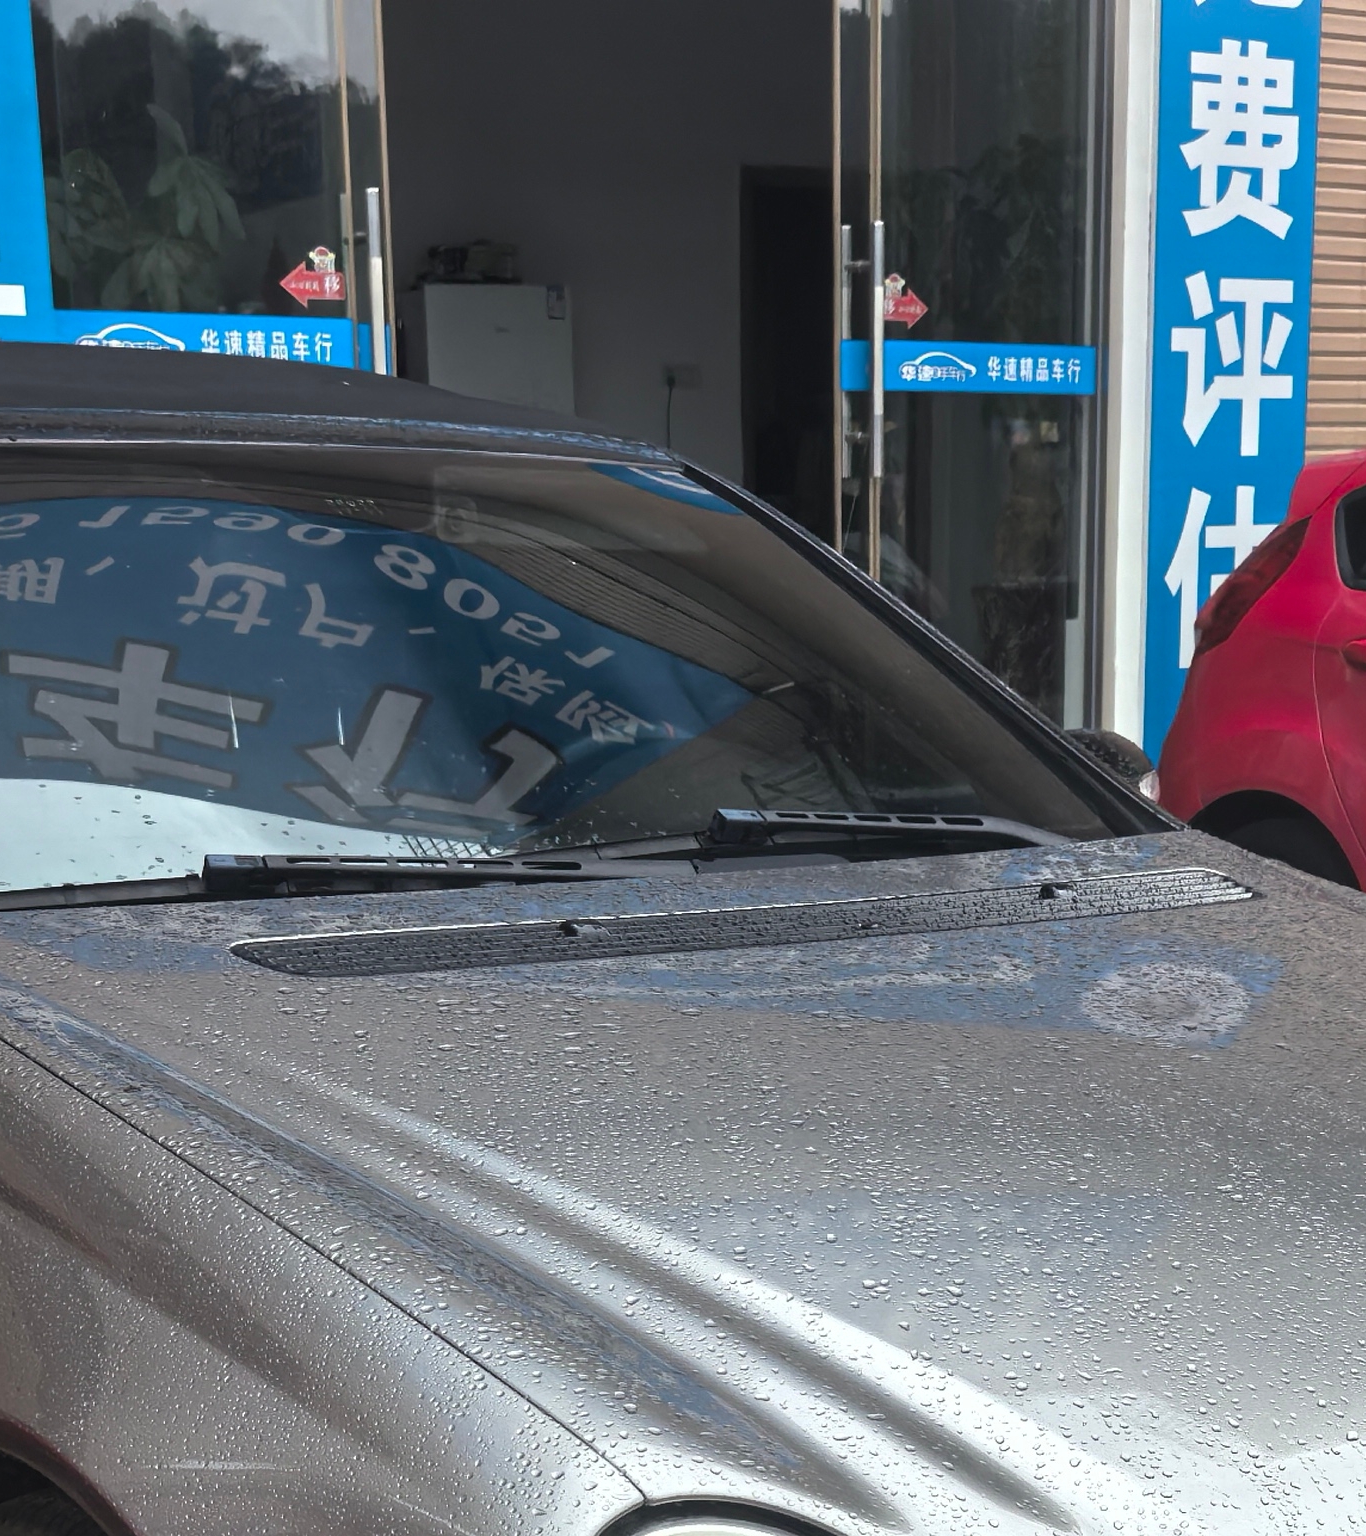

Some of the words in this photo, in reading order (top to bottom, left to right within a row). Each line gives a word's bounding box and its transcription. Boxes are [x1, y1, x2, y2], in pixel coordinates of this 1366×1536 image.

[200, 328, 333, 362] 华速精品车行
[987, 355, 1082, 384] 华速精品车行
